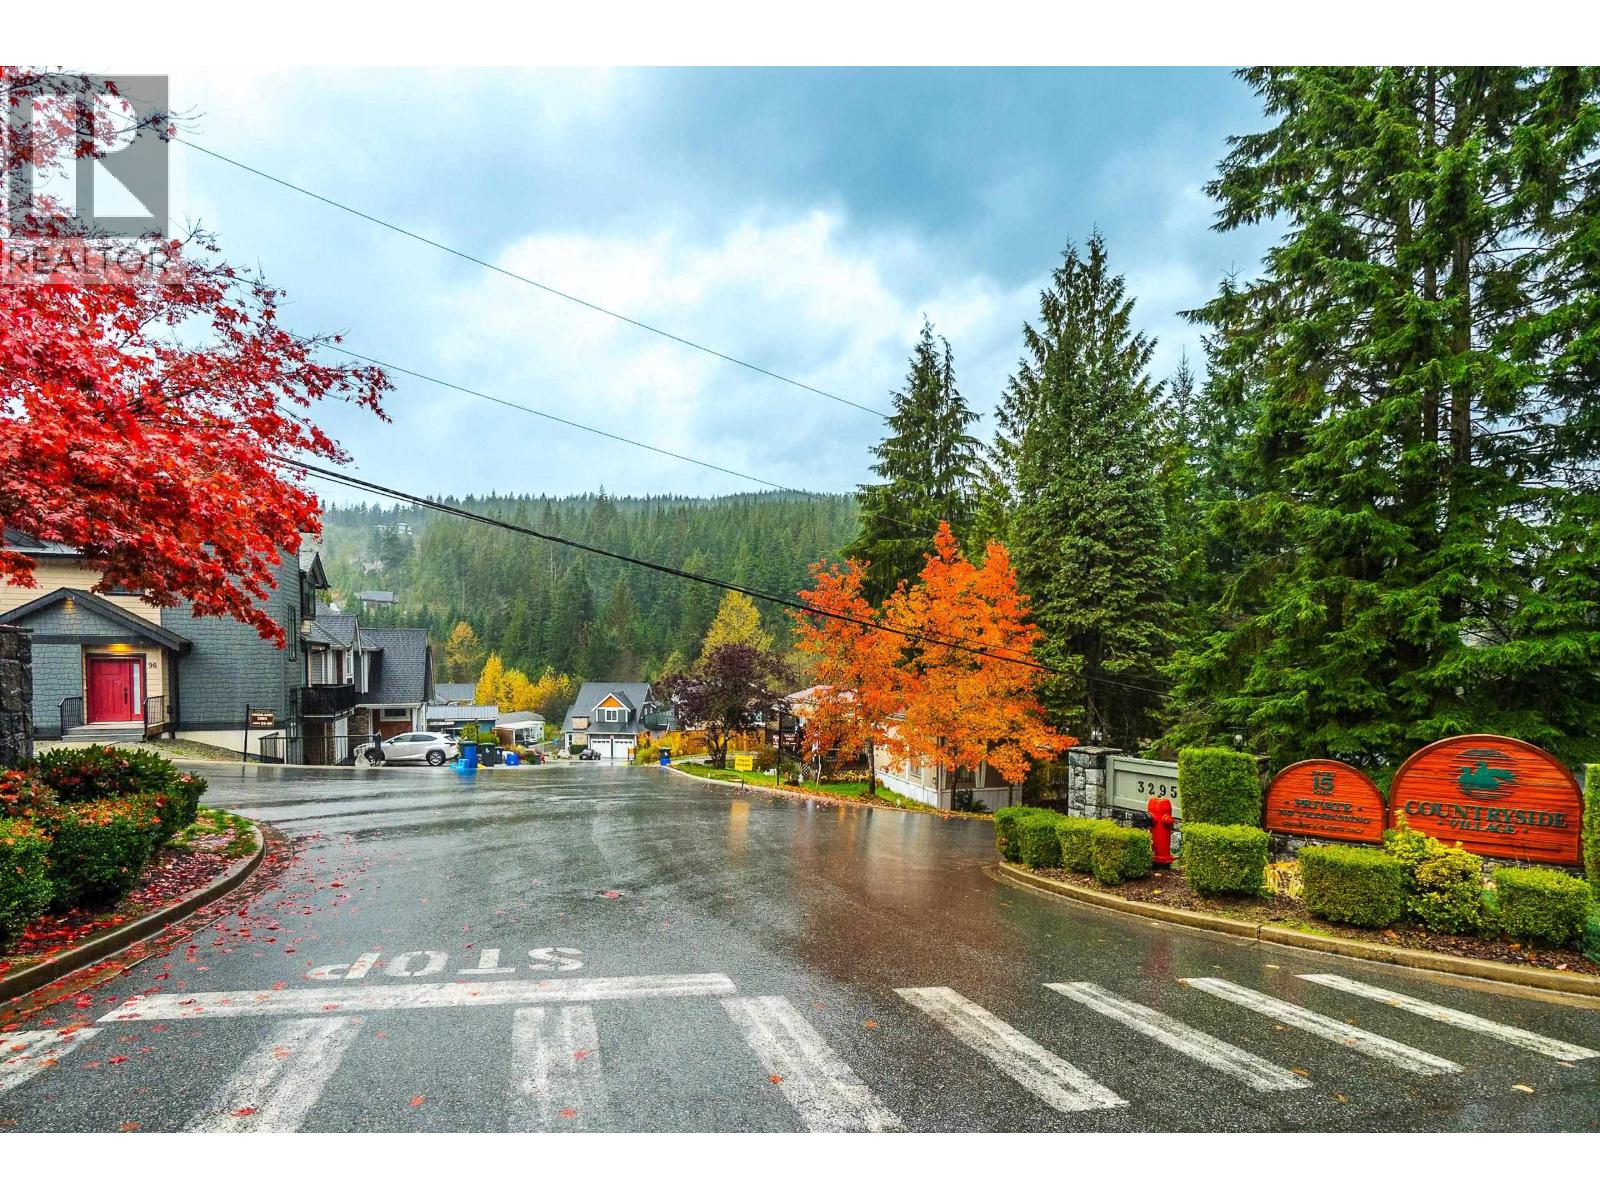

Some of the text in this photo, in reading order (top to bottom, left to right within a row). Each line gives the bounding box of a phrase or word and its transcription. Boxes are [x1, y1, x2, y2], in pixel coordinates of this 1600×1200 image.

[1137, 780, 1178, 799] 3295
[1313, 774, 1334, 792] 15
[1294, 799, 1353, 812] PRIVATE
[1403, 800, 1568, 828] COUNTRYSIDE
[1448, 819, 1516, 834] VILLAGE
[306, 947, 584, 980] STOP
